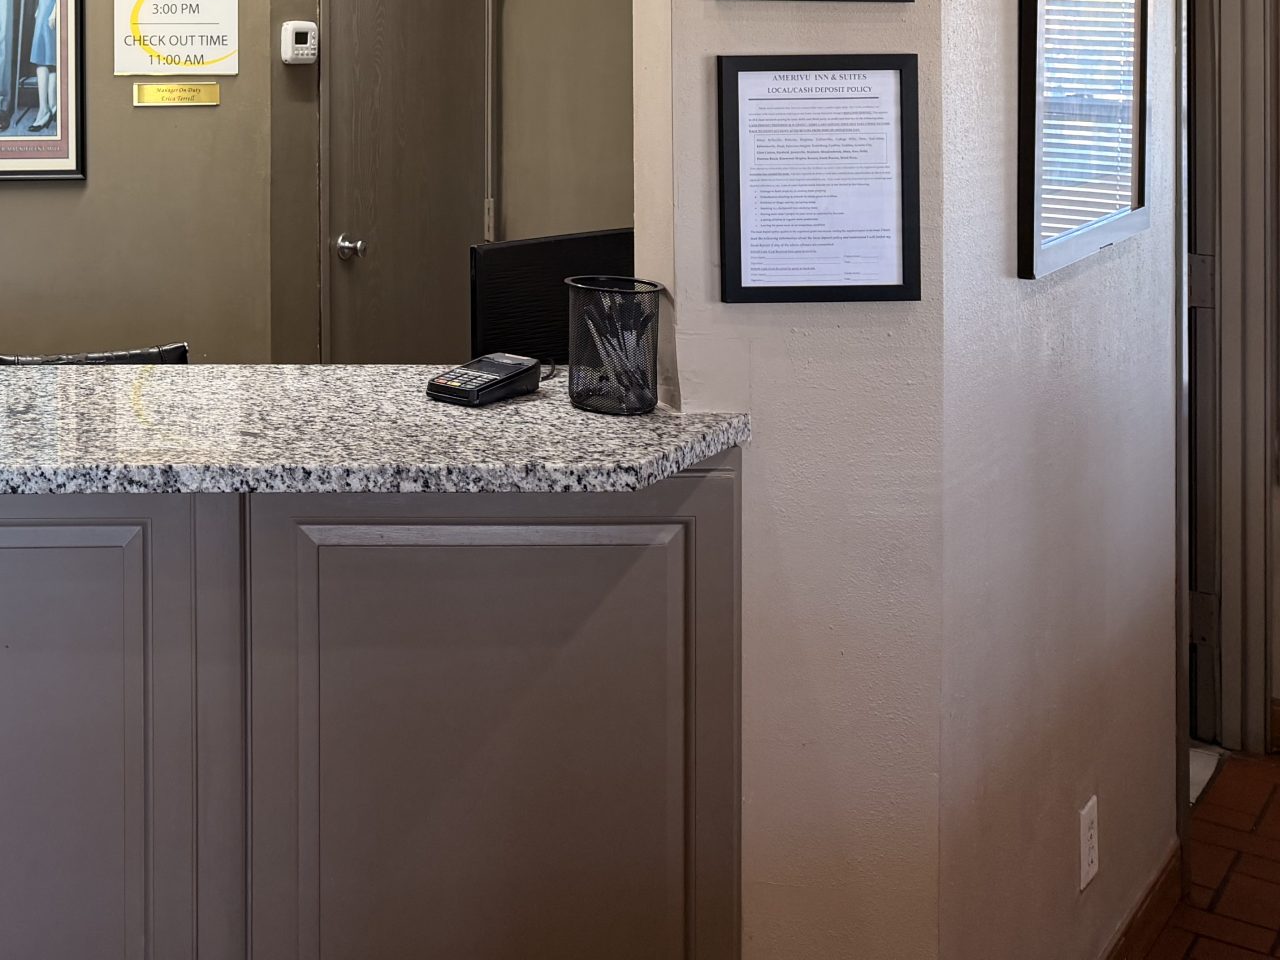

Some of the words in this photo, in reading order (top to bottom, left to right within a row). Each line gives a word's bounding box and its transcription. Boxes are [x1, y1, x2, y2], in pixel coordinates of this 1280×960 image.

[152, 4, 177, 15] 3:00
[182, 4, 200, 14] PM
[124, 35, 166, 46] CHECK
[169, 35, 196, 46] OUT
[199, 35, 228, 46] TIME
[149, 55, 181, 66] 11:00
[184, 55, 205, 65] AM
